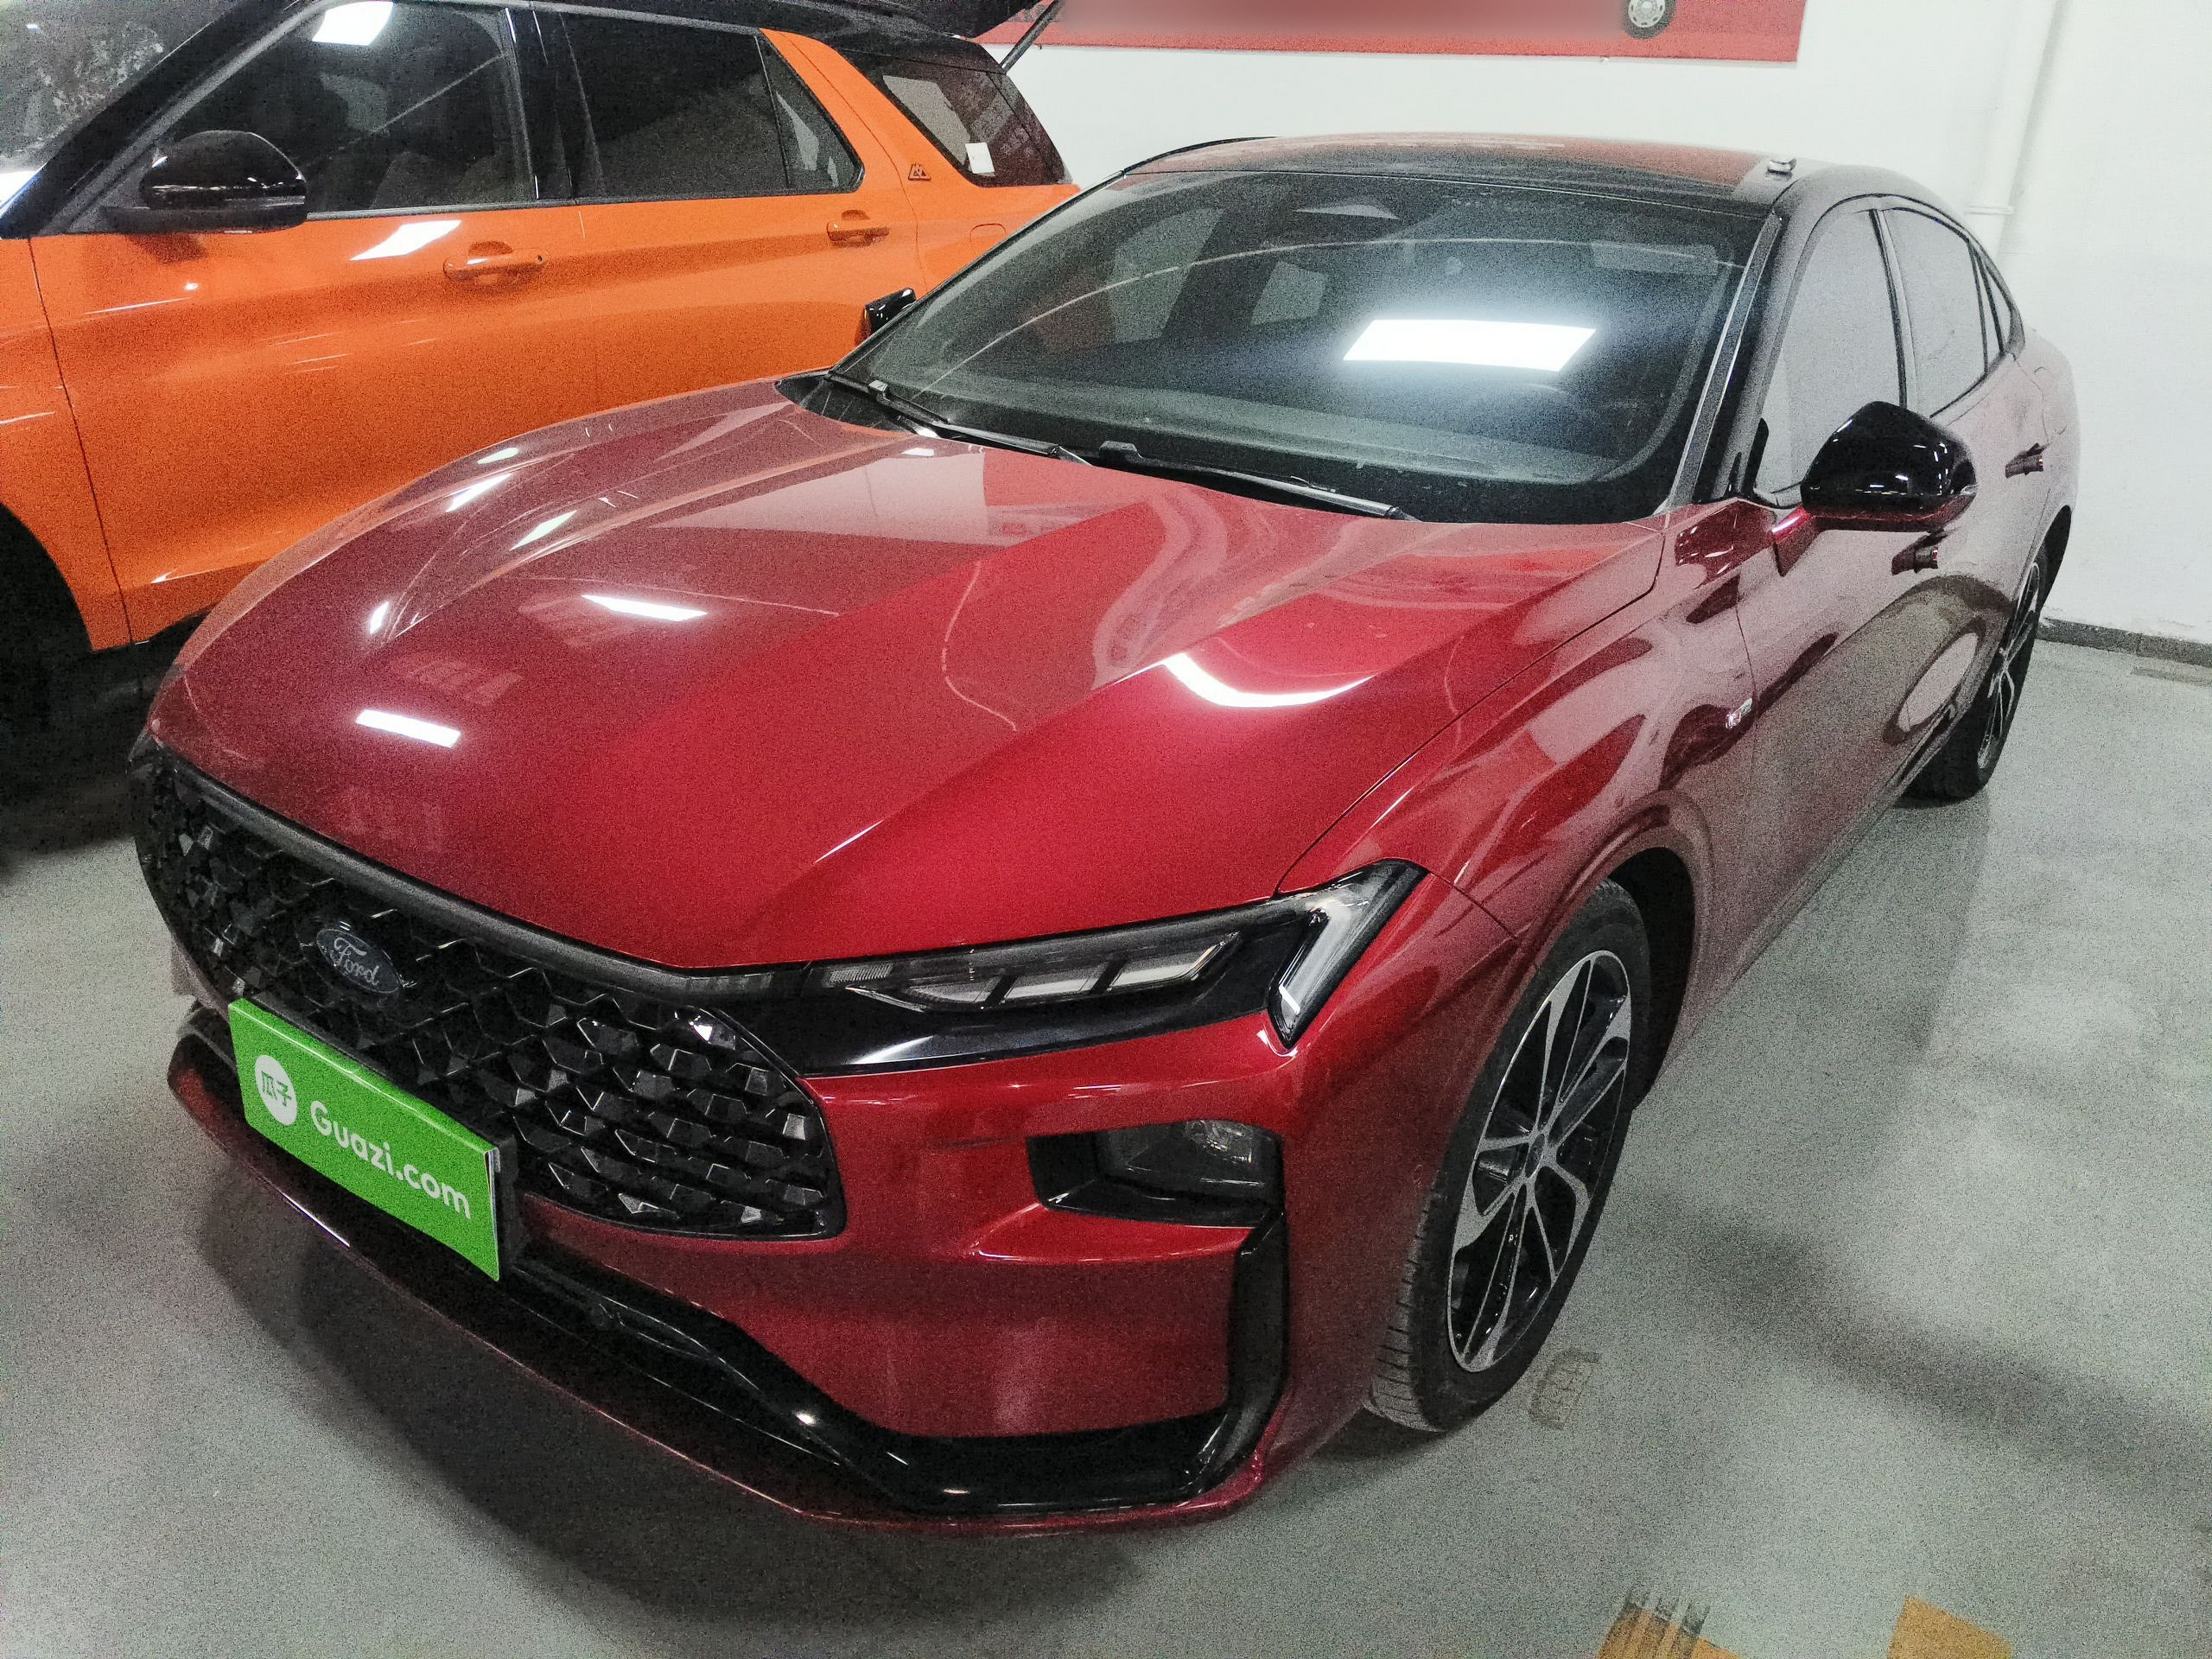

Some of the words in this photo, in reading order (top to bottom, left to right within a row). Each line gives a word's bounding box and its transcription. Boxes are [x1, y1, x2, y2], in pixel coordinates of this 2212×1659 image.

[330, 937, 383, 986] Ford
[262, 1070, 292, 1107] 瓜子
[310, 1100, 471, 1219] Guazi.com
